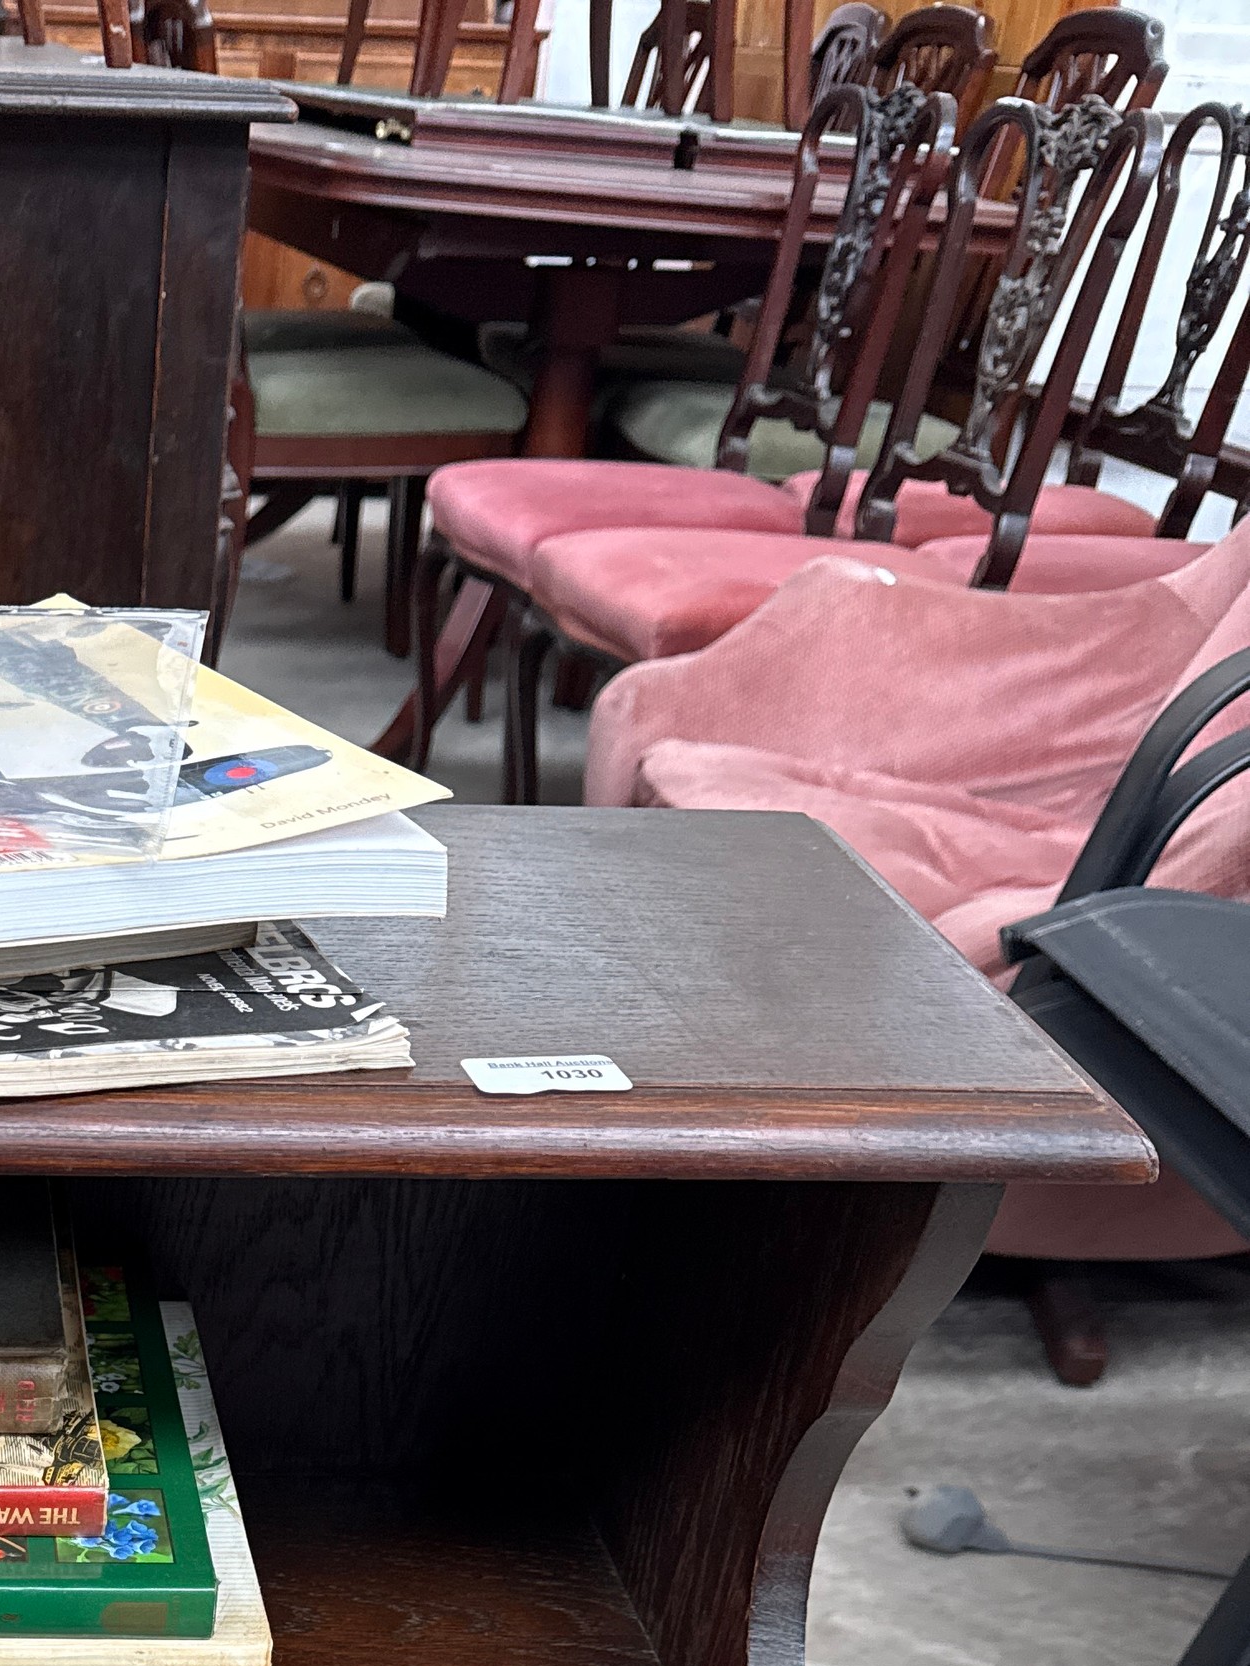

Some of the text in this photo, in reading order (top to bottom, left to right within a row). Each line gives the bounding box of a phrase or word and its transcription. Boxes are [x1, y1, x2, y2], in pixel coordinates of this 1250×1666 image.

[260, 793, 392, 829] David Mondey
[541, 1069, 603, 1080] 1030
[39, 1506, 81, 1526] THE
